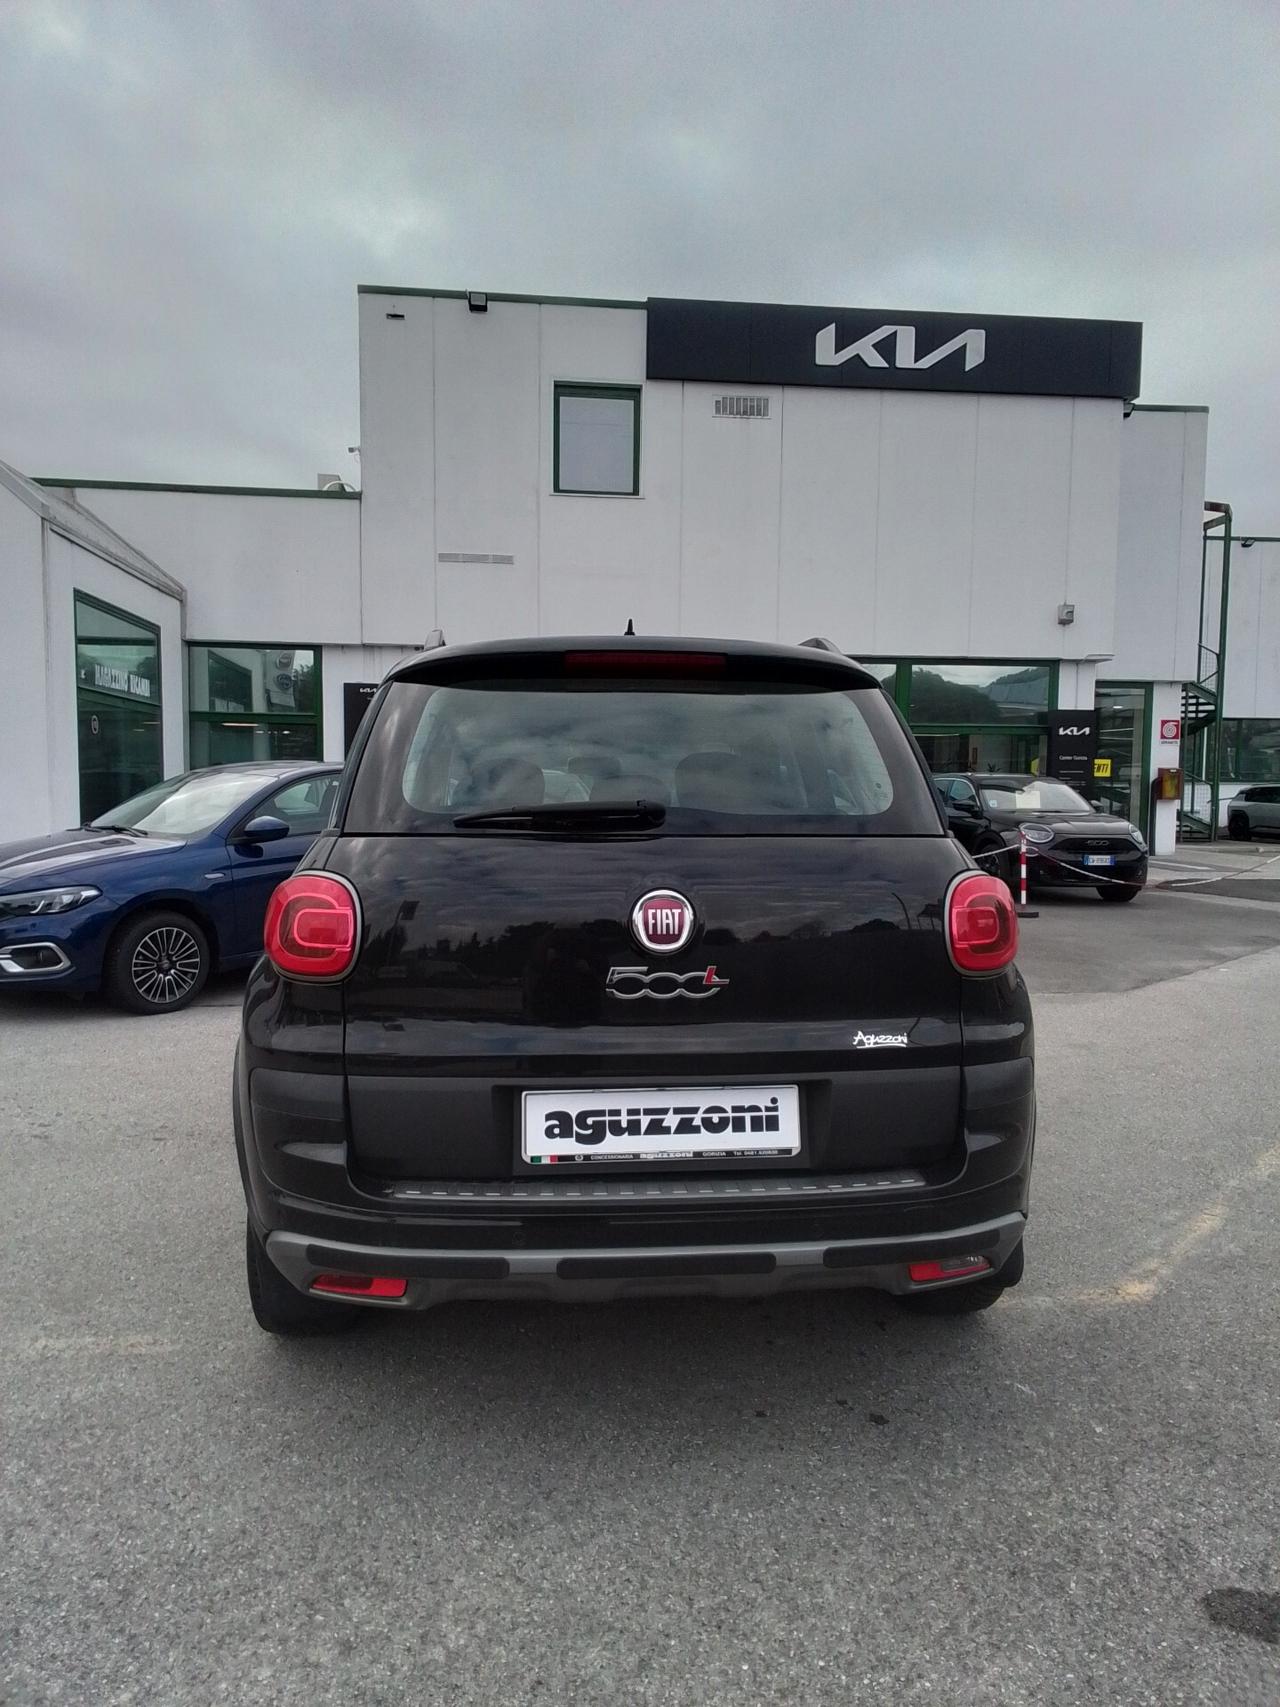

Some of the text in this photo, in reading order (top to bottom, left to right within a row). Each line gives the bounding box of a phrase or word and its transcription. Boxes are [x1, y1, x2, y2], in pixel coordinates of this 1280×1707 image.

[815, 322, 986, 372] KIA
[1058, 726, 1091, 736] KIA
[647, 908, 682, 935] FIAT
[605, 965, 730, 1000] 500L
[544, 1096, 780, 1145] aguzzoni
